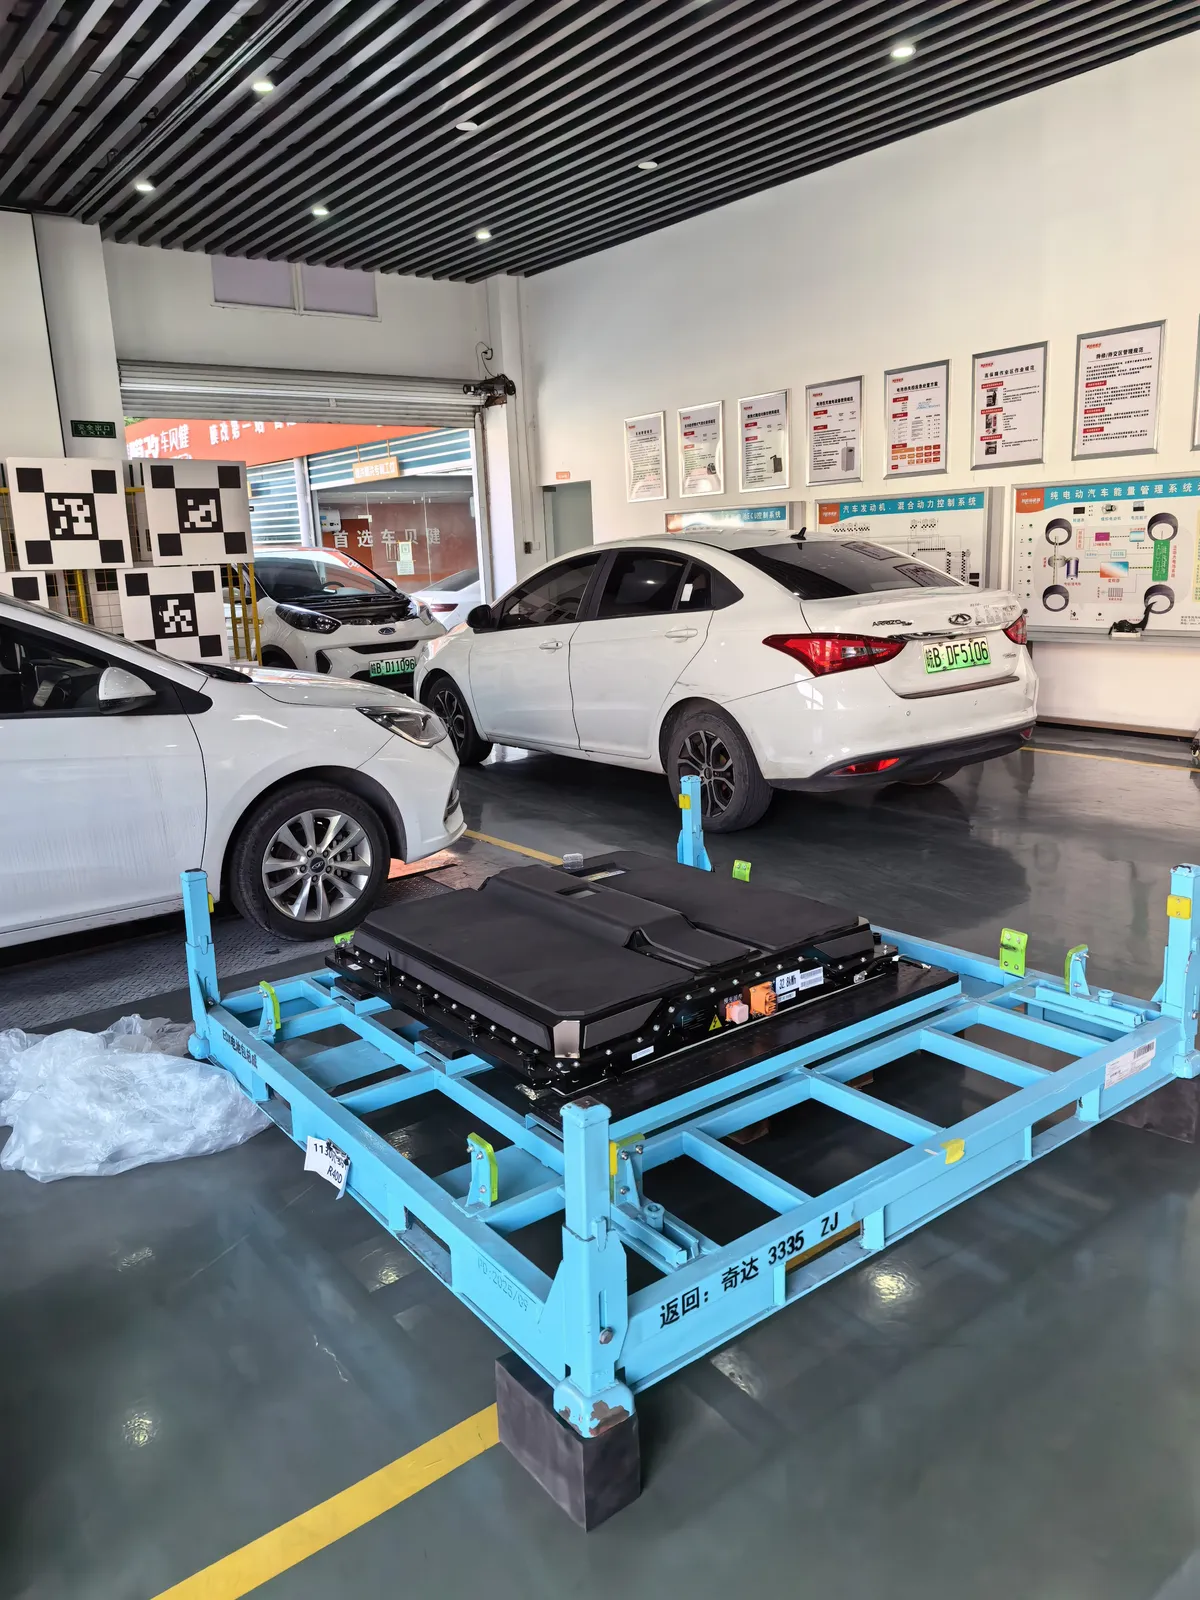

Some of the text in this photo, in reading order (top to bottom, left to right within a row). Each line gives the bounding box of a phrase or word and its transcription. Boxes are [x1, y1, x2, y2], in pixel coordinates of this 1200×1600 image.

[1050, 481, 1200, 501] 纯电动汽车能量管理系统
[720, 1257, 759, 1292] 奇达
[767, 1230, 805, 1266] 3335
[820, 1211, 839, 1238] ZJ
